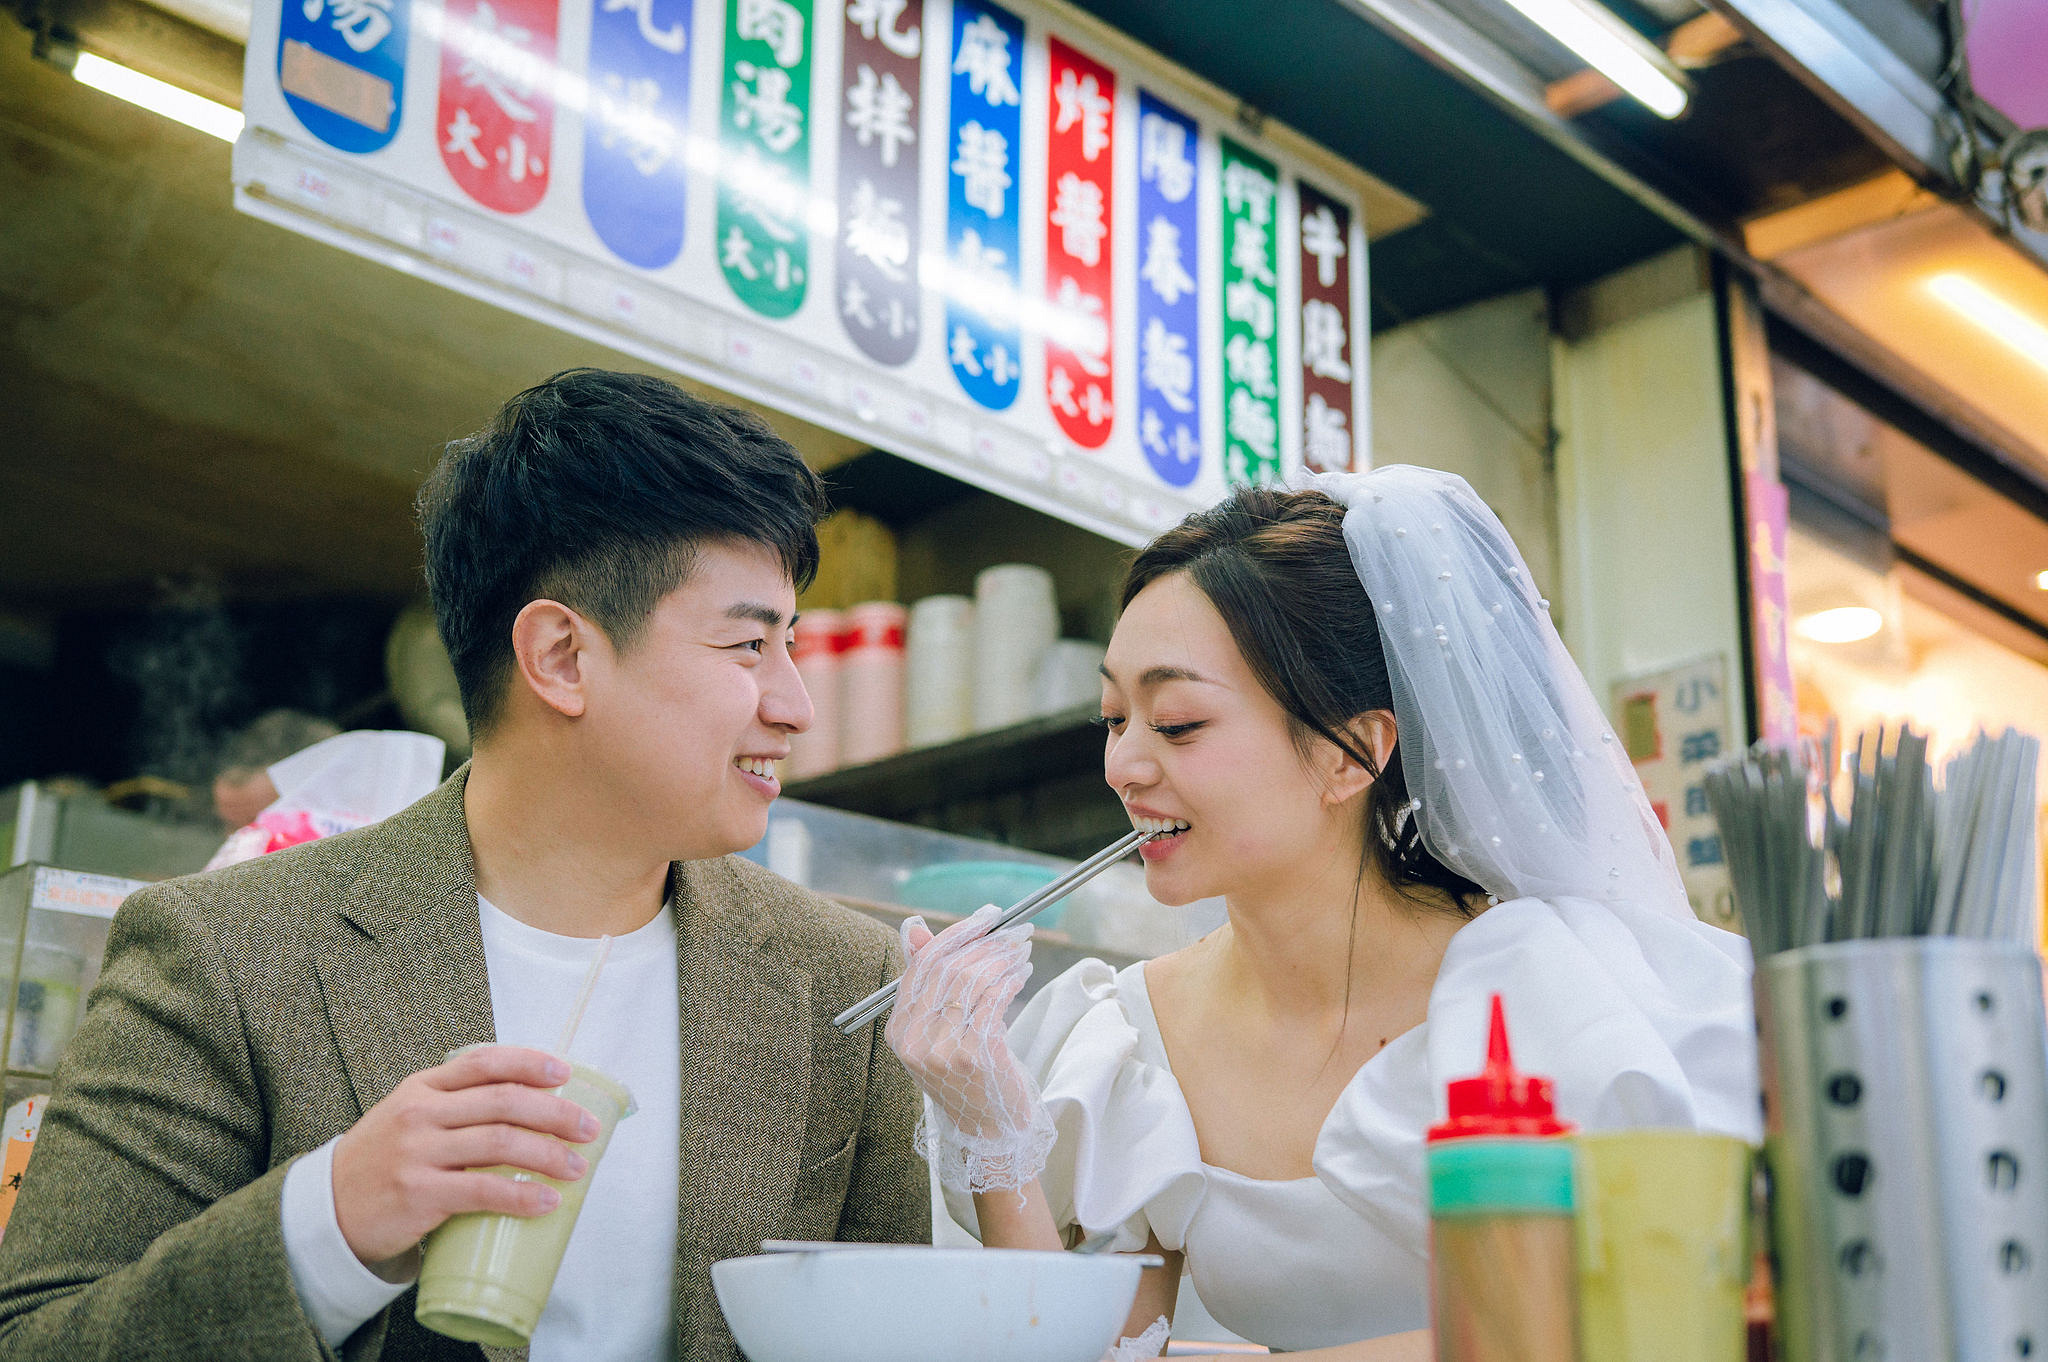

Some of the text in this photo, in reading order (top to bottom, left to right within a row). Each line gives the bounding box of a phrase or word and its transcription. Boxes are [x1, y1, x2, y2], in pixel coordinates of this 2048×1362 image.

[445, 107, 545, 183] 大小
[722, 225, 805, 291] 大小
[1141, 112, 1196, 413] 陽春麵
[843, 280, 917, 338] 大小
[950, 326, 1020, 386] 大小
[1047, 366, 1113, 425] 大小
[1142, 407, 1199, 464] 大小
